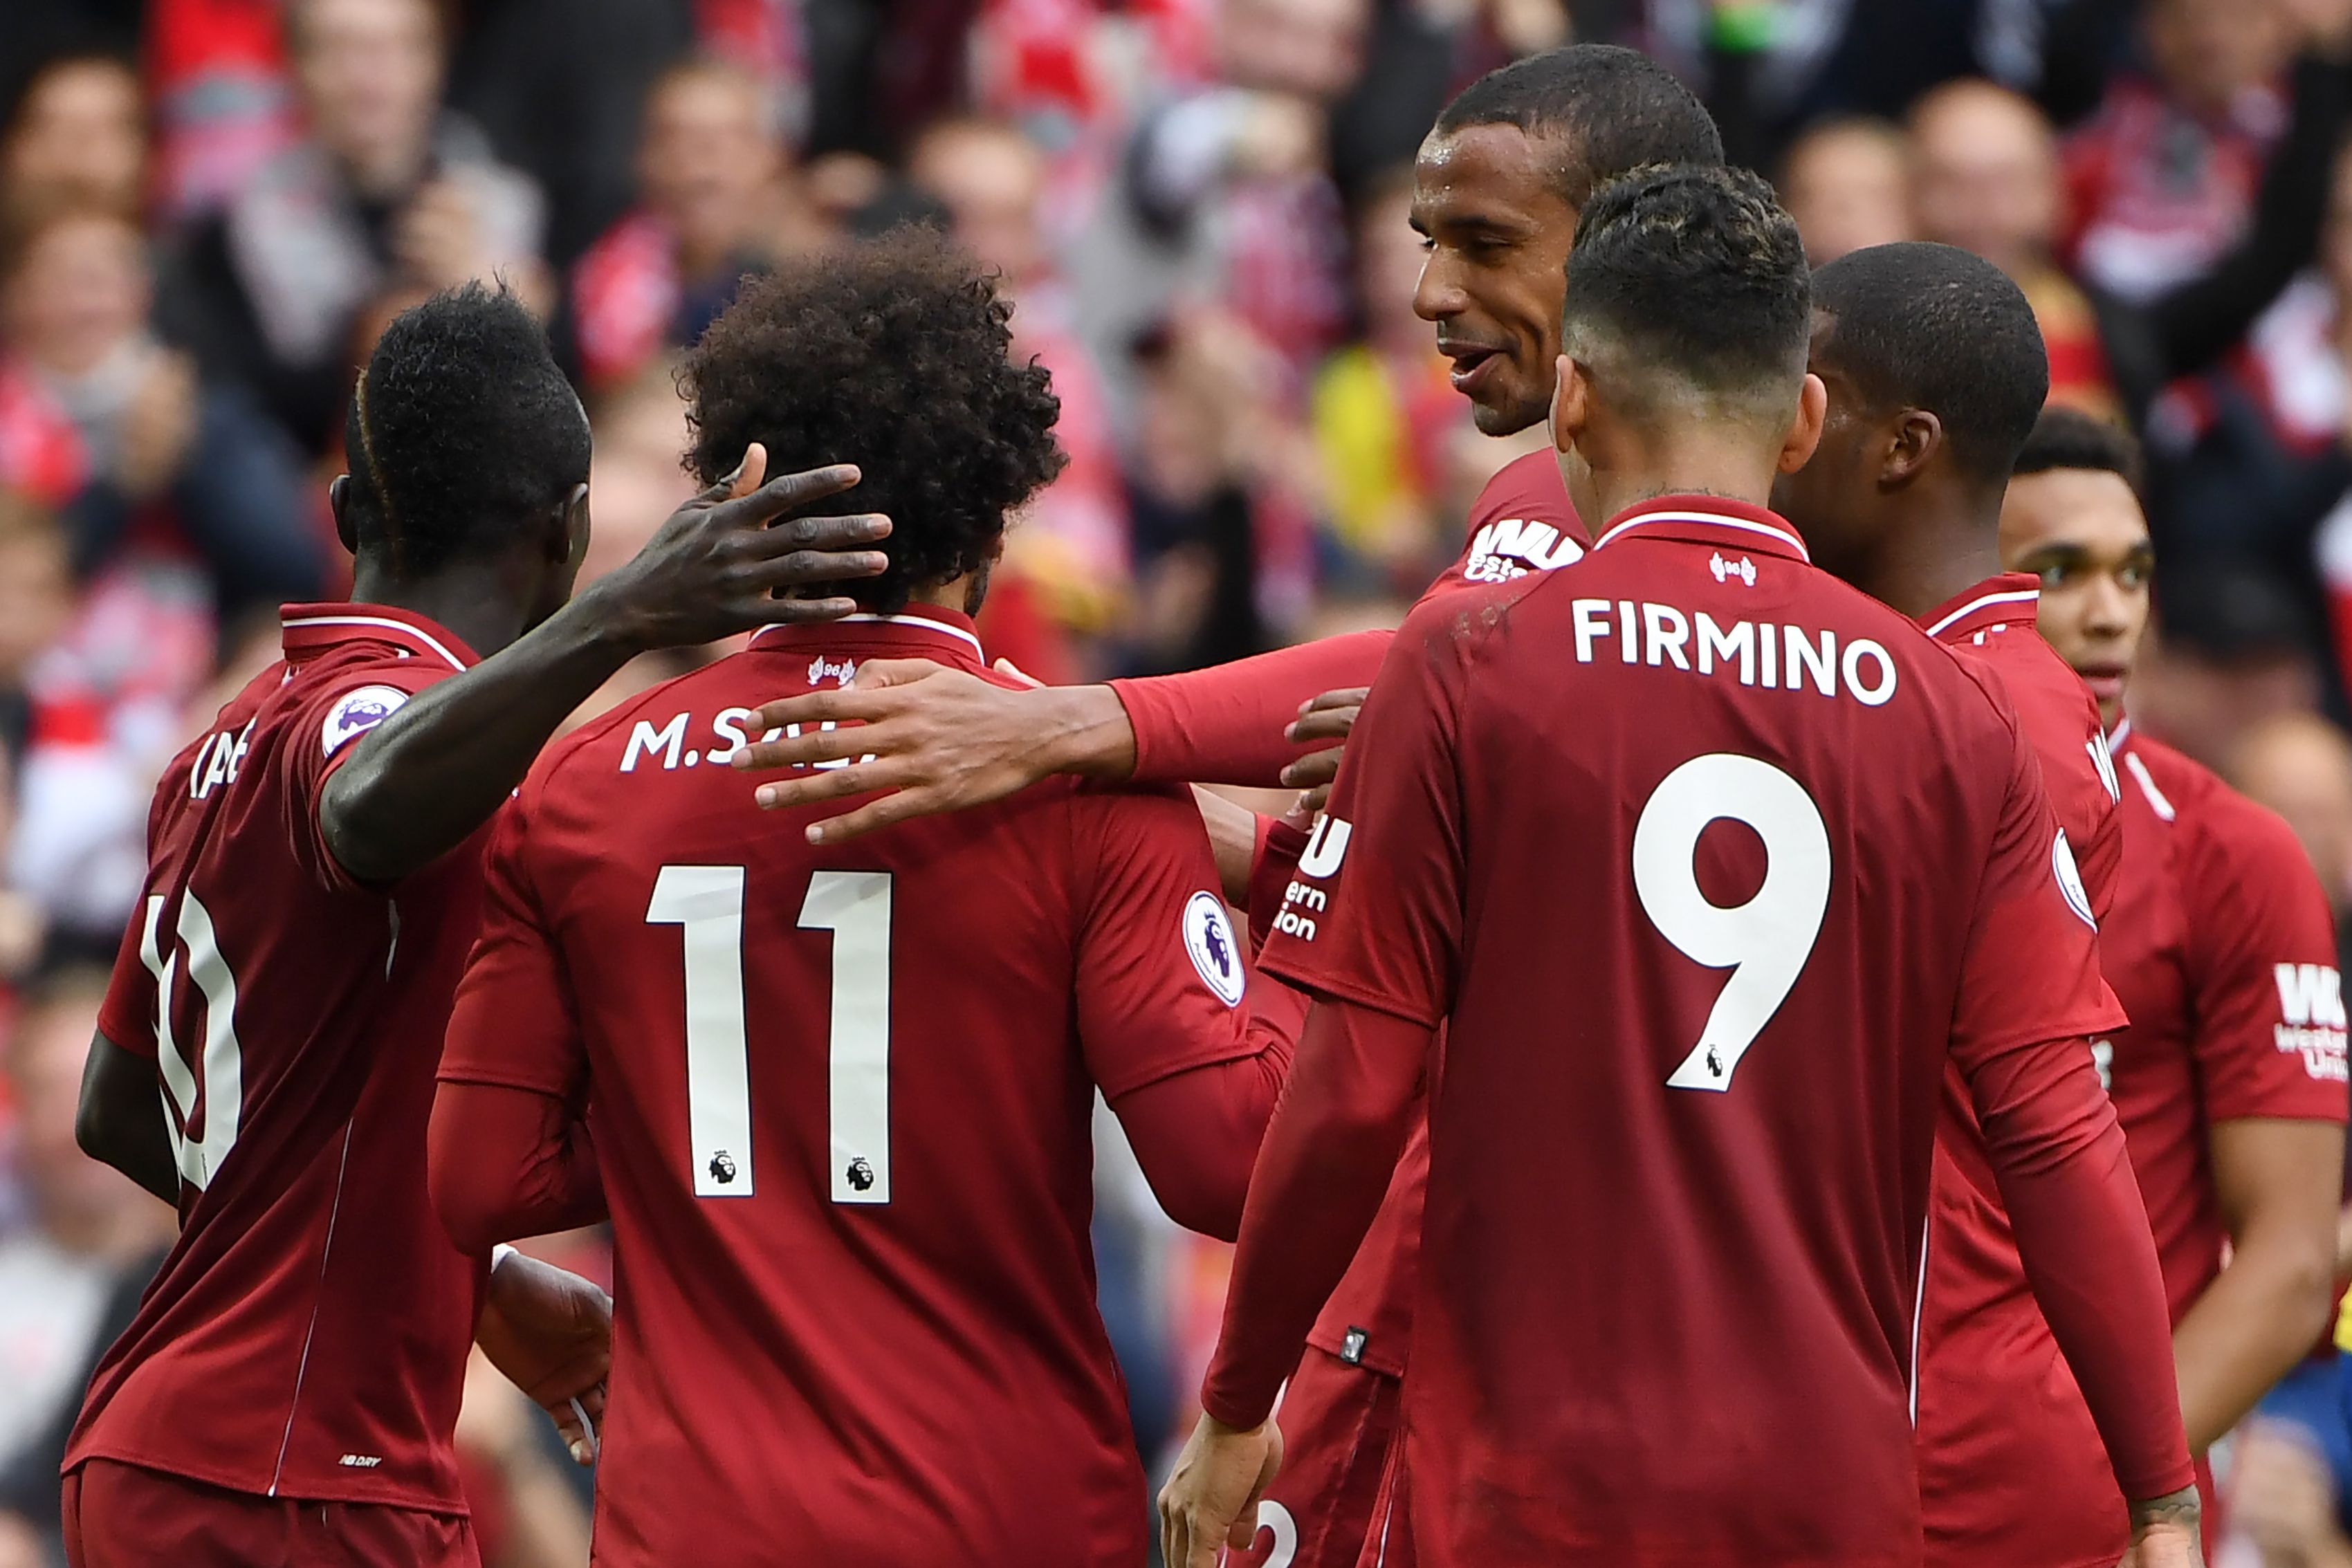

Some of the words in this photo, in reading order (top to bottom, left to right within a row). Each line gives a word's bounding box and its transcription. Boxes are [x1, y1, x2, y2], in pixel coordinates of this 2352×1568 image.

[823, 663, 840, 676] 96
[1571, 598, 1898, 706] FIRMINO
[619, 706, 876, 772] M.S
[1272, 901, 1316, 941] ion
[1285, 880, 1327, 912] ern
[1633, 753, 1832, 1093] 9
[645, 865, 893, 1204] 11
